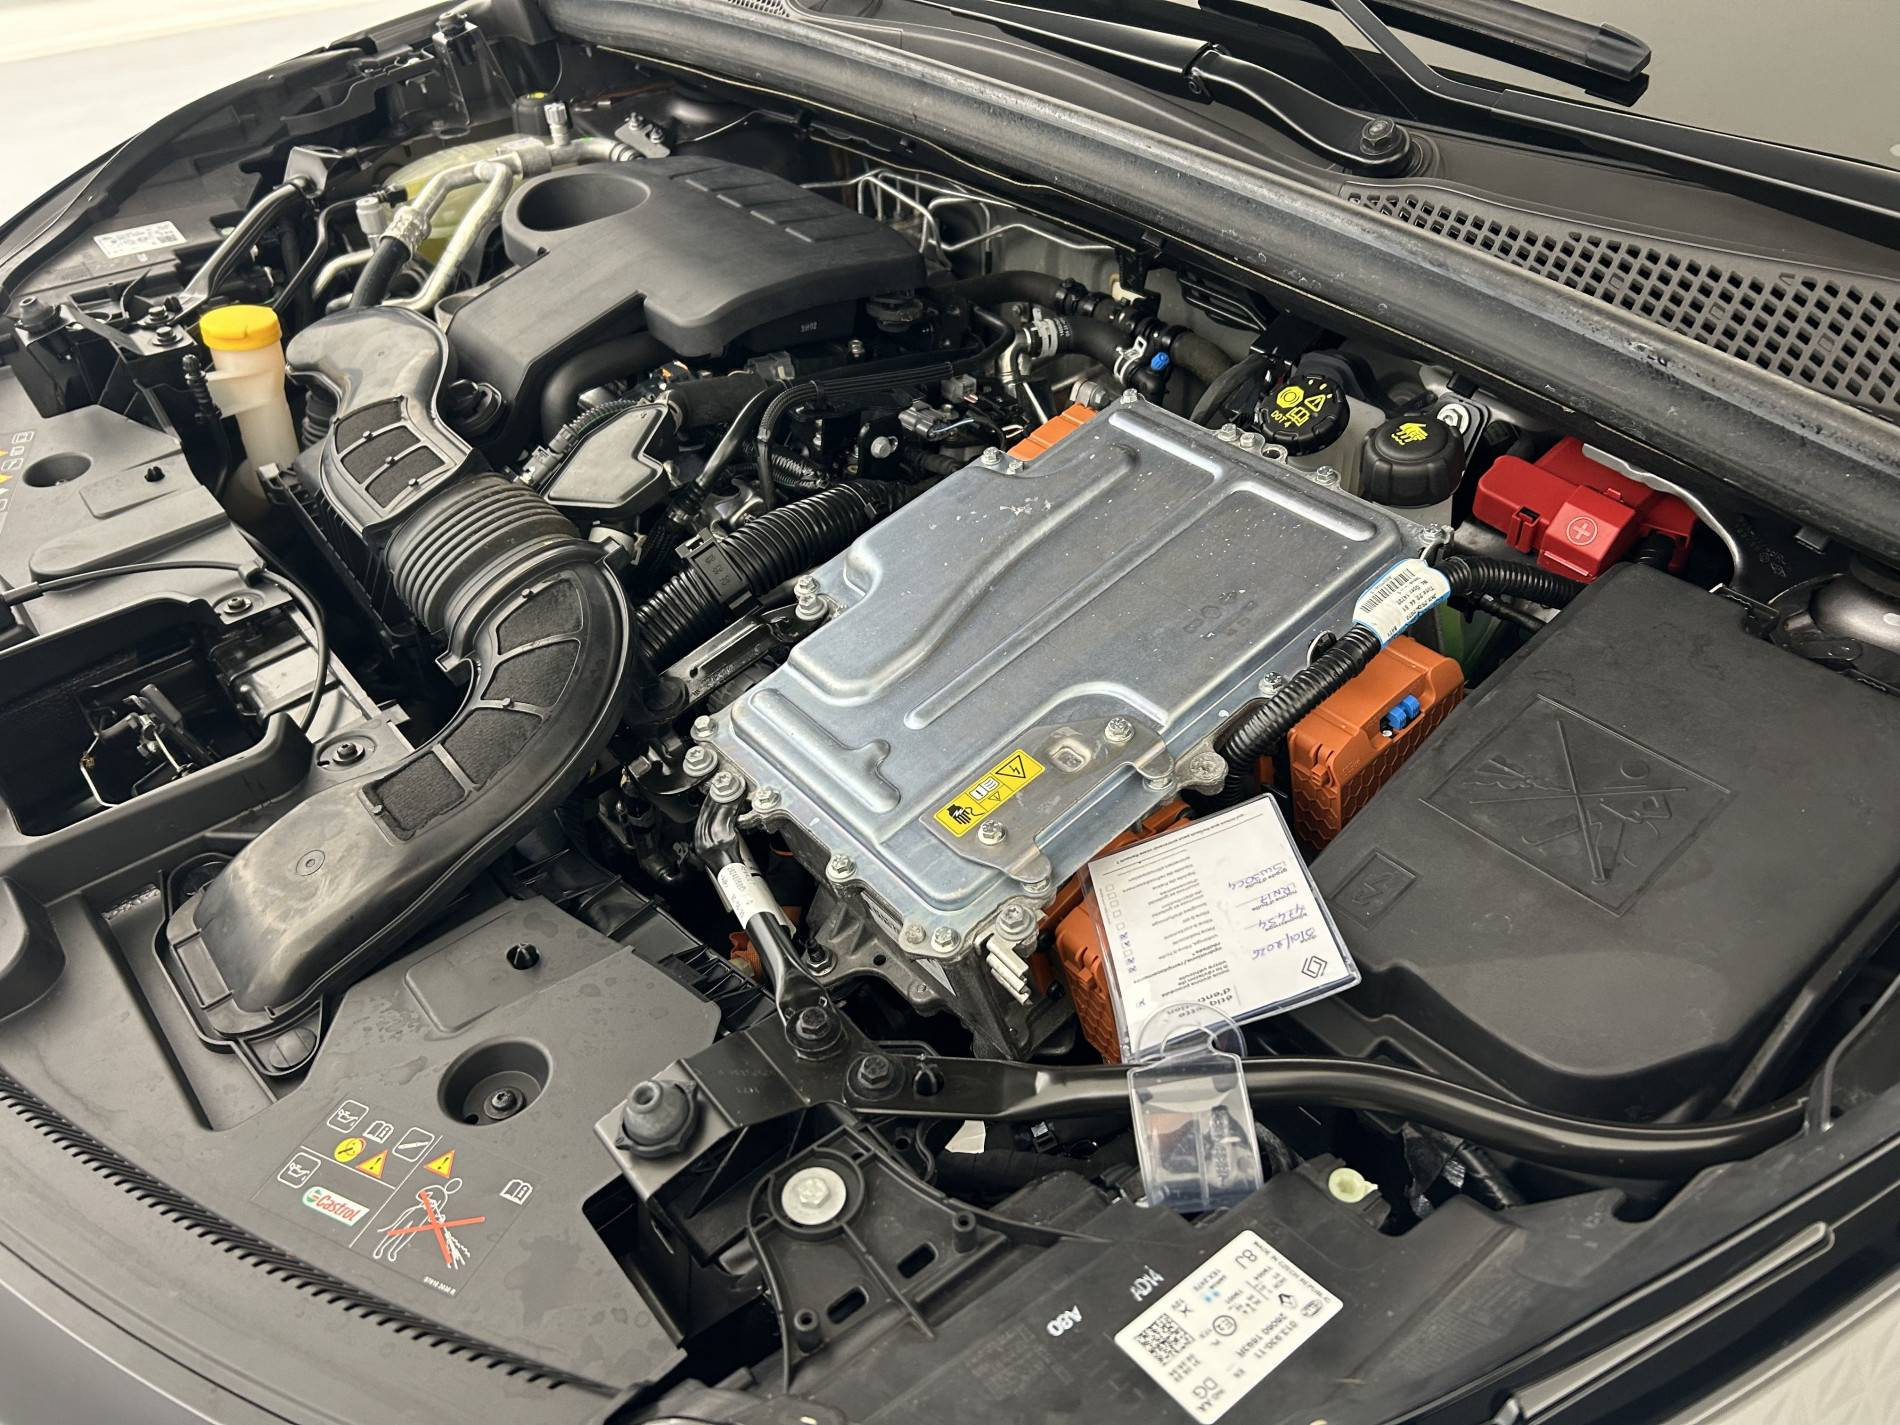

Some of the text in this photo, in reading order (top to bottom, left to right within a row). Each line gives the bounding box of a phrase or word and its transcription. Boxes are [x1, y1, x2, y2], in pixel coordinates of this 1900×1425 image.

[1270, 409, 1288, 423] DOT
[1178, 994, 1232, 1017] étiqette
[316, 1194, 361, 1222] Castrol
[1234, 1248, 1258, 1269] 8J
[1191, 1376, 1218, 1399] DG
